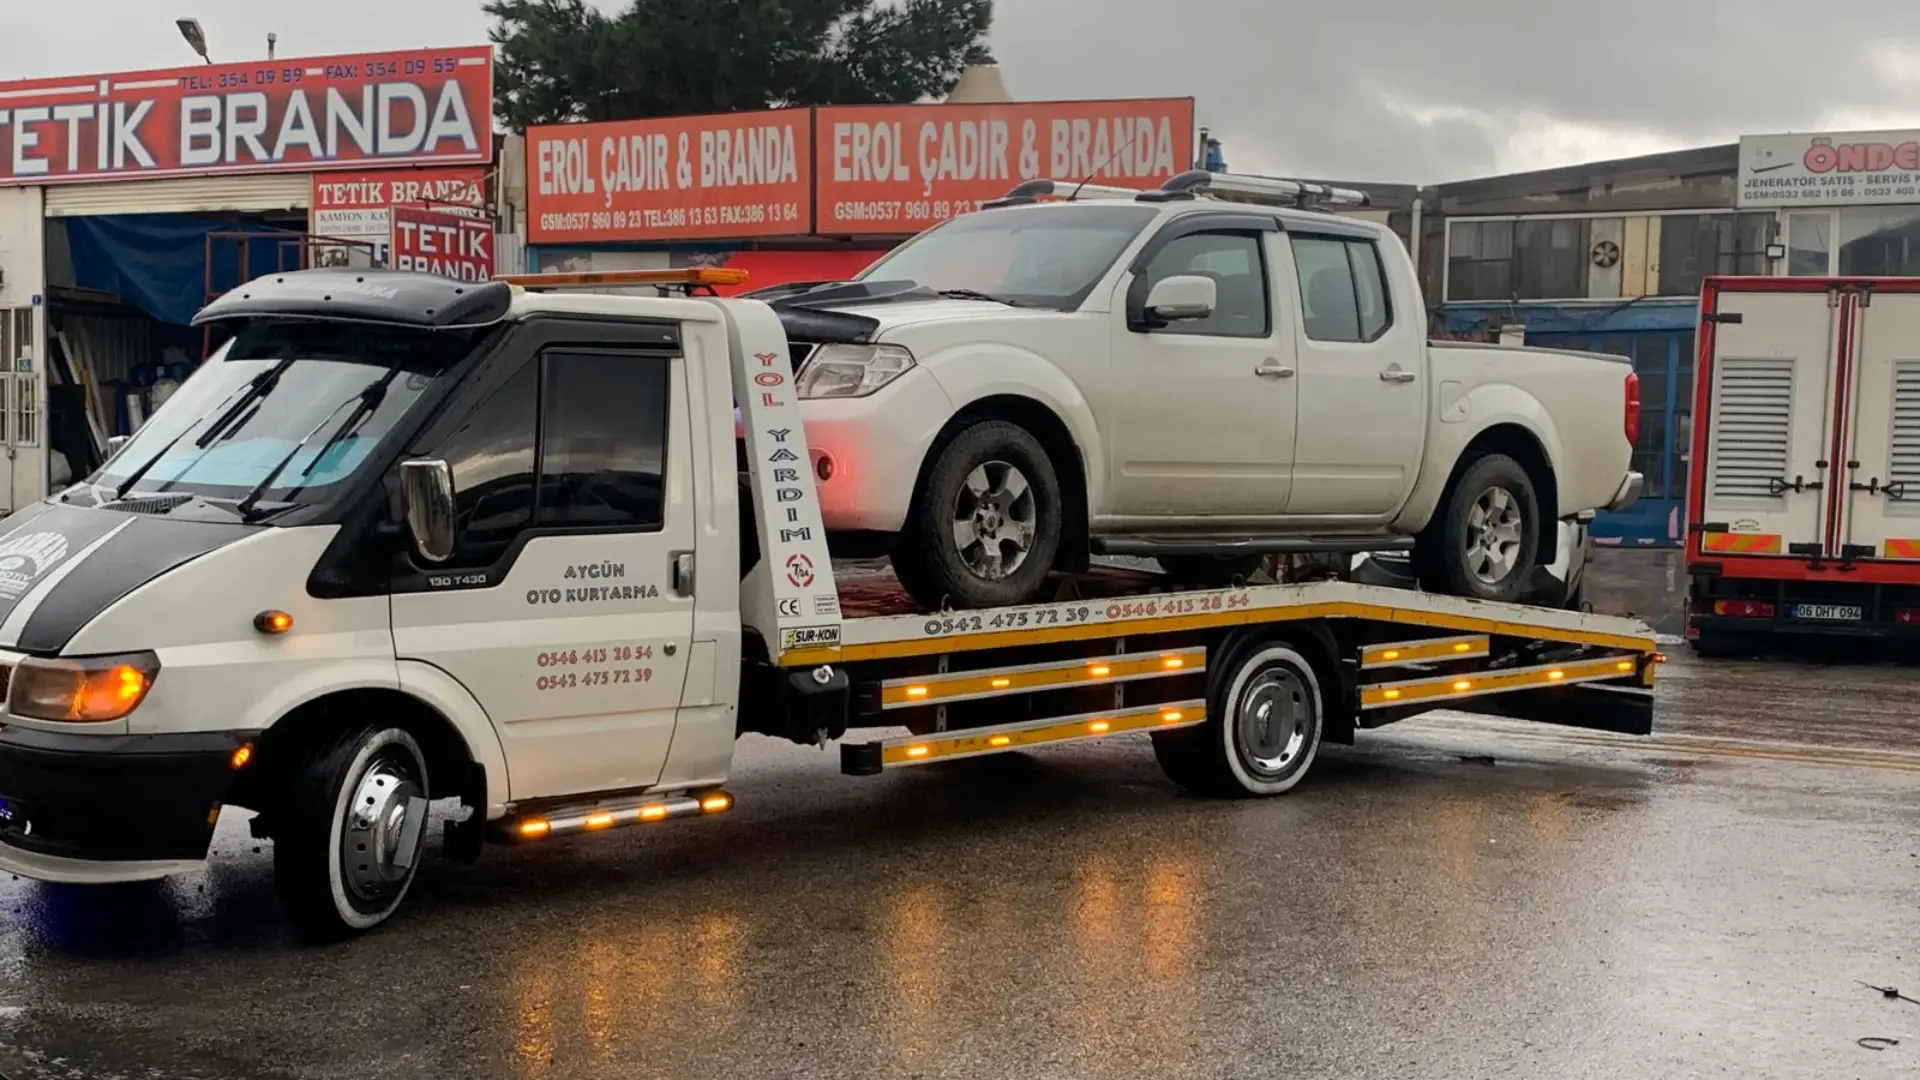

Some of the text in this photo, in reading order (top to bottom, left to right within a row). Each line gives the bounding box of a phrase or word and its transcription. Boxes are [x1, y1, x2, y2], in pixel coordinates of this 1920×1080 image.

[179, 75, 212, 91] TEL:
[218, 72, 248, 88] 354
[255, 70, 276, 85] 09
[324, 65, 358, 80] FAX:
[364, 62, 397, 77] 354
[404, 59, 426, 74] 09
[434, 57, 456, 72] 55
[0, 79, 478, 175] ETİK BRANDA
[538, 124, 798, 208] EROL ÇADIR & BRANDA
[833, 114, 1176, 198] EROL ÇADIR & BRANDA
[1803, 136, 1920, 174] ÖNDE
[318, 177, 485, 206] TETİK BRANDA
[1743, 175, 1818, 189] JENERATÖR
[1866, 173, 1912, 185] SERVİS
[540, 211, 590, 231] GSM:0537
[592, 210, 612, 230] 960
[628, 208, 642, 228] 23
[644, 207, 686, 228] TEL:386
[688, 206, 702, 226] 13
[704, 205, 718, 226] 63
[720, 203, 765, 224] FAX:386
[767, 202, 781, 223] 13
[783, 201, 798, 222] 64
[834, 200, 902, 221] GSM:0537
[904, 200, 930, 221] 960
[933, 199, 950, 221] 89
[397, 219, 490, 260] TETİK
[753, 352, 785, 408] YOL
[766, 427, 812, 543] YARDIM
[428, 574, 487, 588] 130 T430
[563, 559, 626, 579] AYGÜN
[526, 584, 660, 605] OTO KURTARMA
[923, 615, 983, 636] 0542
[989, 611, 1029, 630] 475
[1035, 609, 1059, 625] 72
[1066, 606, 1090, 623] 39
[1105, 600, 1158, 619] 0546
[1162, 598, 1194, 614] 413
[1200, 595, 1223, 611] 28
[1227, 593, 1249, 608] 54
[1799, 604, 1861, 619] 06 DHT 094
[795, 628, 839, 643] SUR-KON
[537, 649, 578, 668] 0546
[582, 647, 608, 664] 413
[635, 644, 653, 660] 54
[536, 667, 653, 691] 0542 475 72 39
